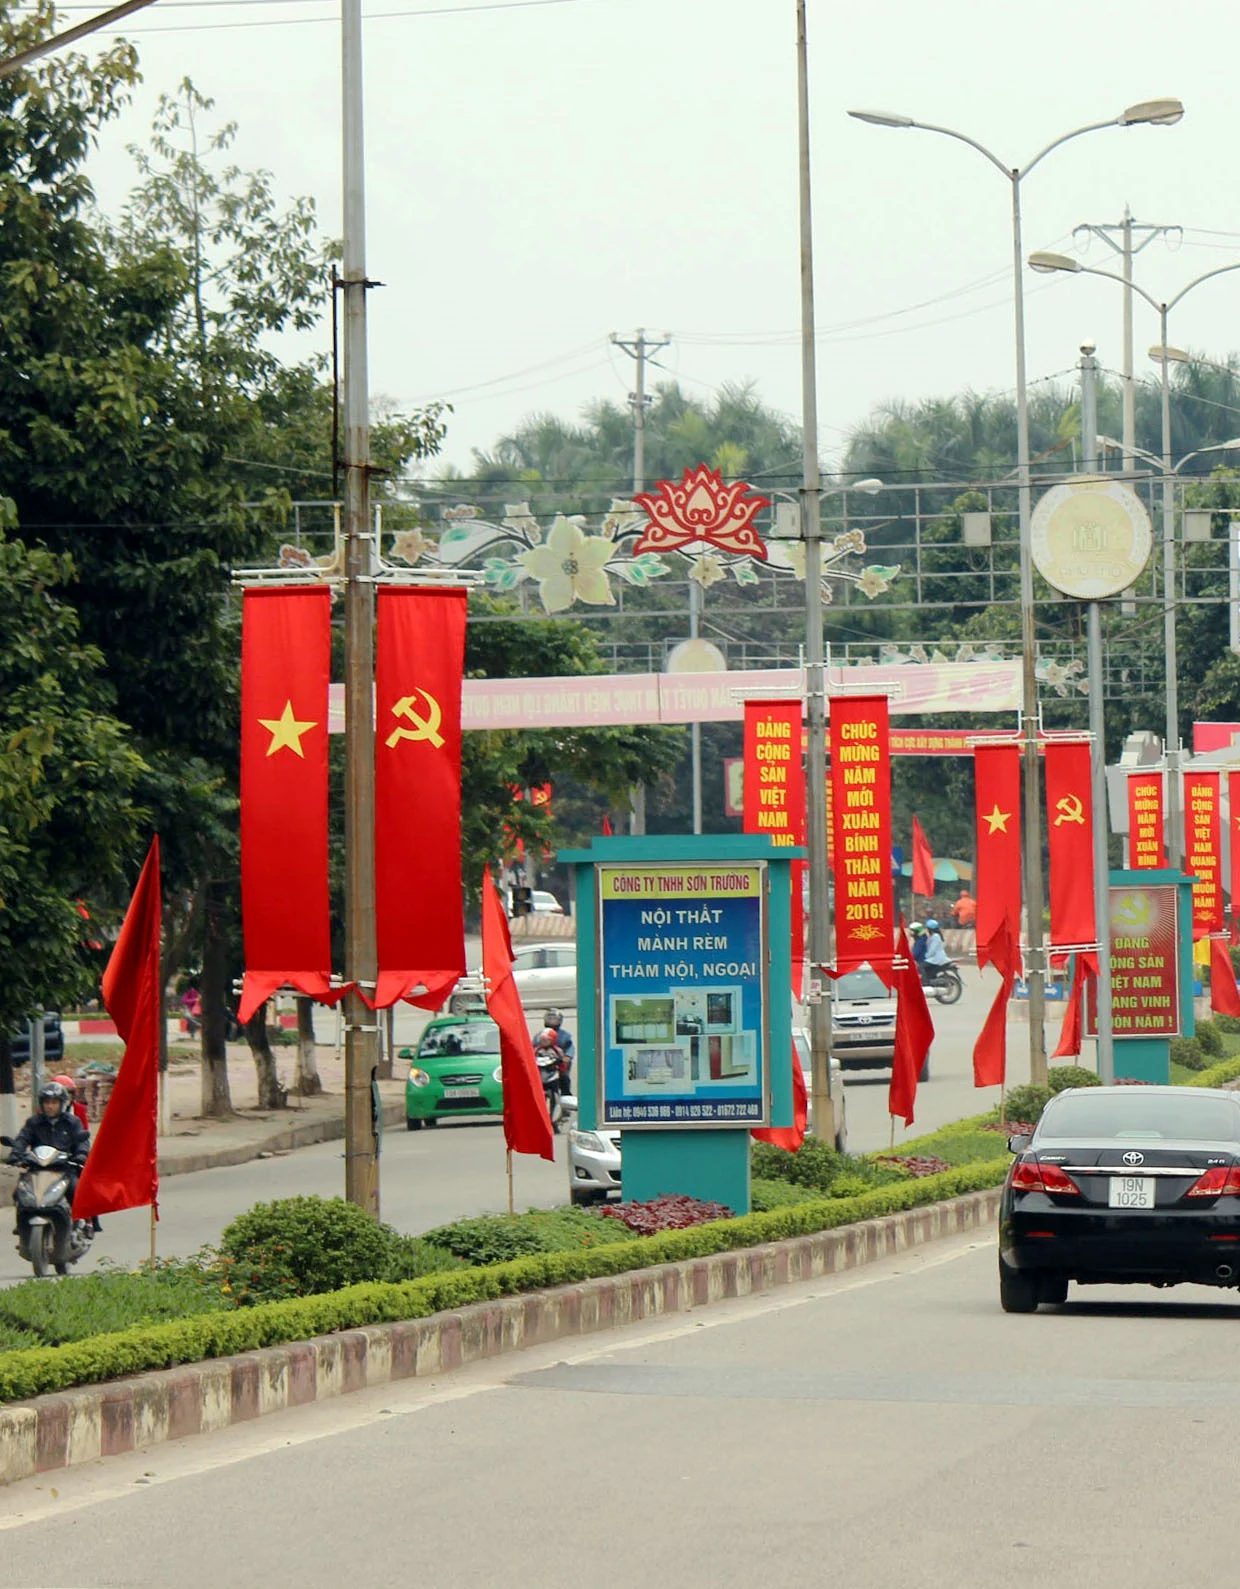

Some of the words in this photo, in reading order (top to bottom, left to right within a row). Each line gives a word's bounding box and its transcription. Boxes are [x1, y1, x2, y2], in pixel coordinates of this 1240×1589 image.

[757, 716, 790, 738] ĐẢNG
[842, 720, 877, 739] CHÚC
[757, 742, 790, 762] CỘNG
[840, 742, 880, 762] MỪNG
[760, 761, 786, 782] SẢN
[844, 766, 876, 784] NĂM
[760, 786, 786, 808] VIỆT
[847, 786, 874, 807] MỚI
[1136, 784, 1158, 796] CHÚC
[1192, 784, 1213, 797] ĐẢNG
[758, 812, 788, 828] NAM
[843, 810, 880, 830] XUÂN
[845, 832, 878, 852] BÍNH
[844, 855, 880, 875] THÂN
[1190, 856, 1216, 867] QUANG
[613, 874, 640, 892] CÔNG
[644, 876, 655, 892] TY
[658, 876, 683, 892] TNHH
[687, 874, 707, 891] SƠN
[710, 872, 750, 890] TRƯỜNG
[848, 878, 880, 897] NĂM
[641, 907, 671, 928] NỘI
[676, 904, 723, 924] THẤT
[846, 903, 884, 920] 2016!
[638, 934, 688, 951] MÀNH
[694, 932, 727, 950] RÈM
[610, 960, 659, 978] THẢM
[664, 960, 698, 980] NỘI,
[703, 963, 756, 979] NGOẠI
[1110, 955, 1135, 972] ỘNG
[1138, 953, 1164, 968] SẢN
[1112, 975, 1129, 991] IỆT
[1133, 976, 1162, 988] NAM
[1112, 996, 1137, 1008] ANG
[1141, 996, 1170, 1008] VINH
[1122, 1178, 1144, 1192] 19N
[1117, 1193, 1147, 1206] 1025
